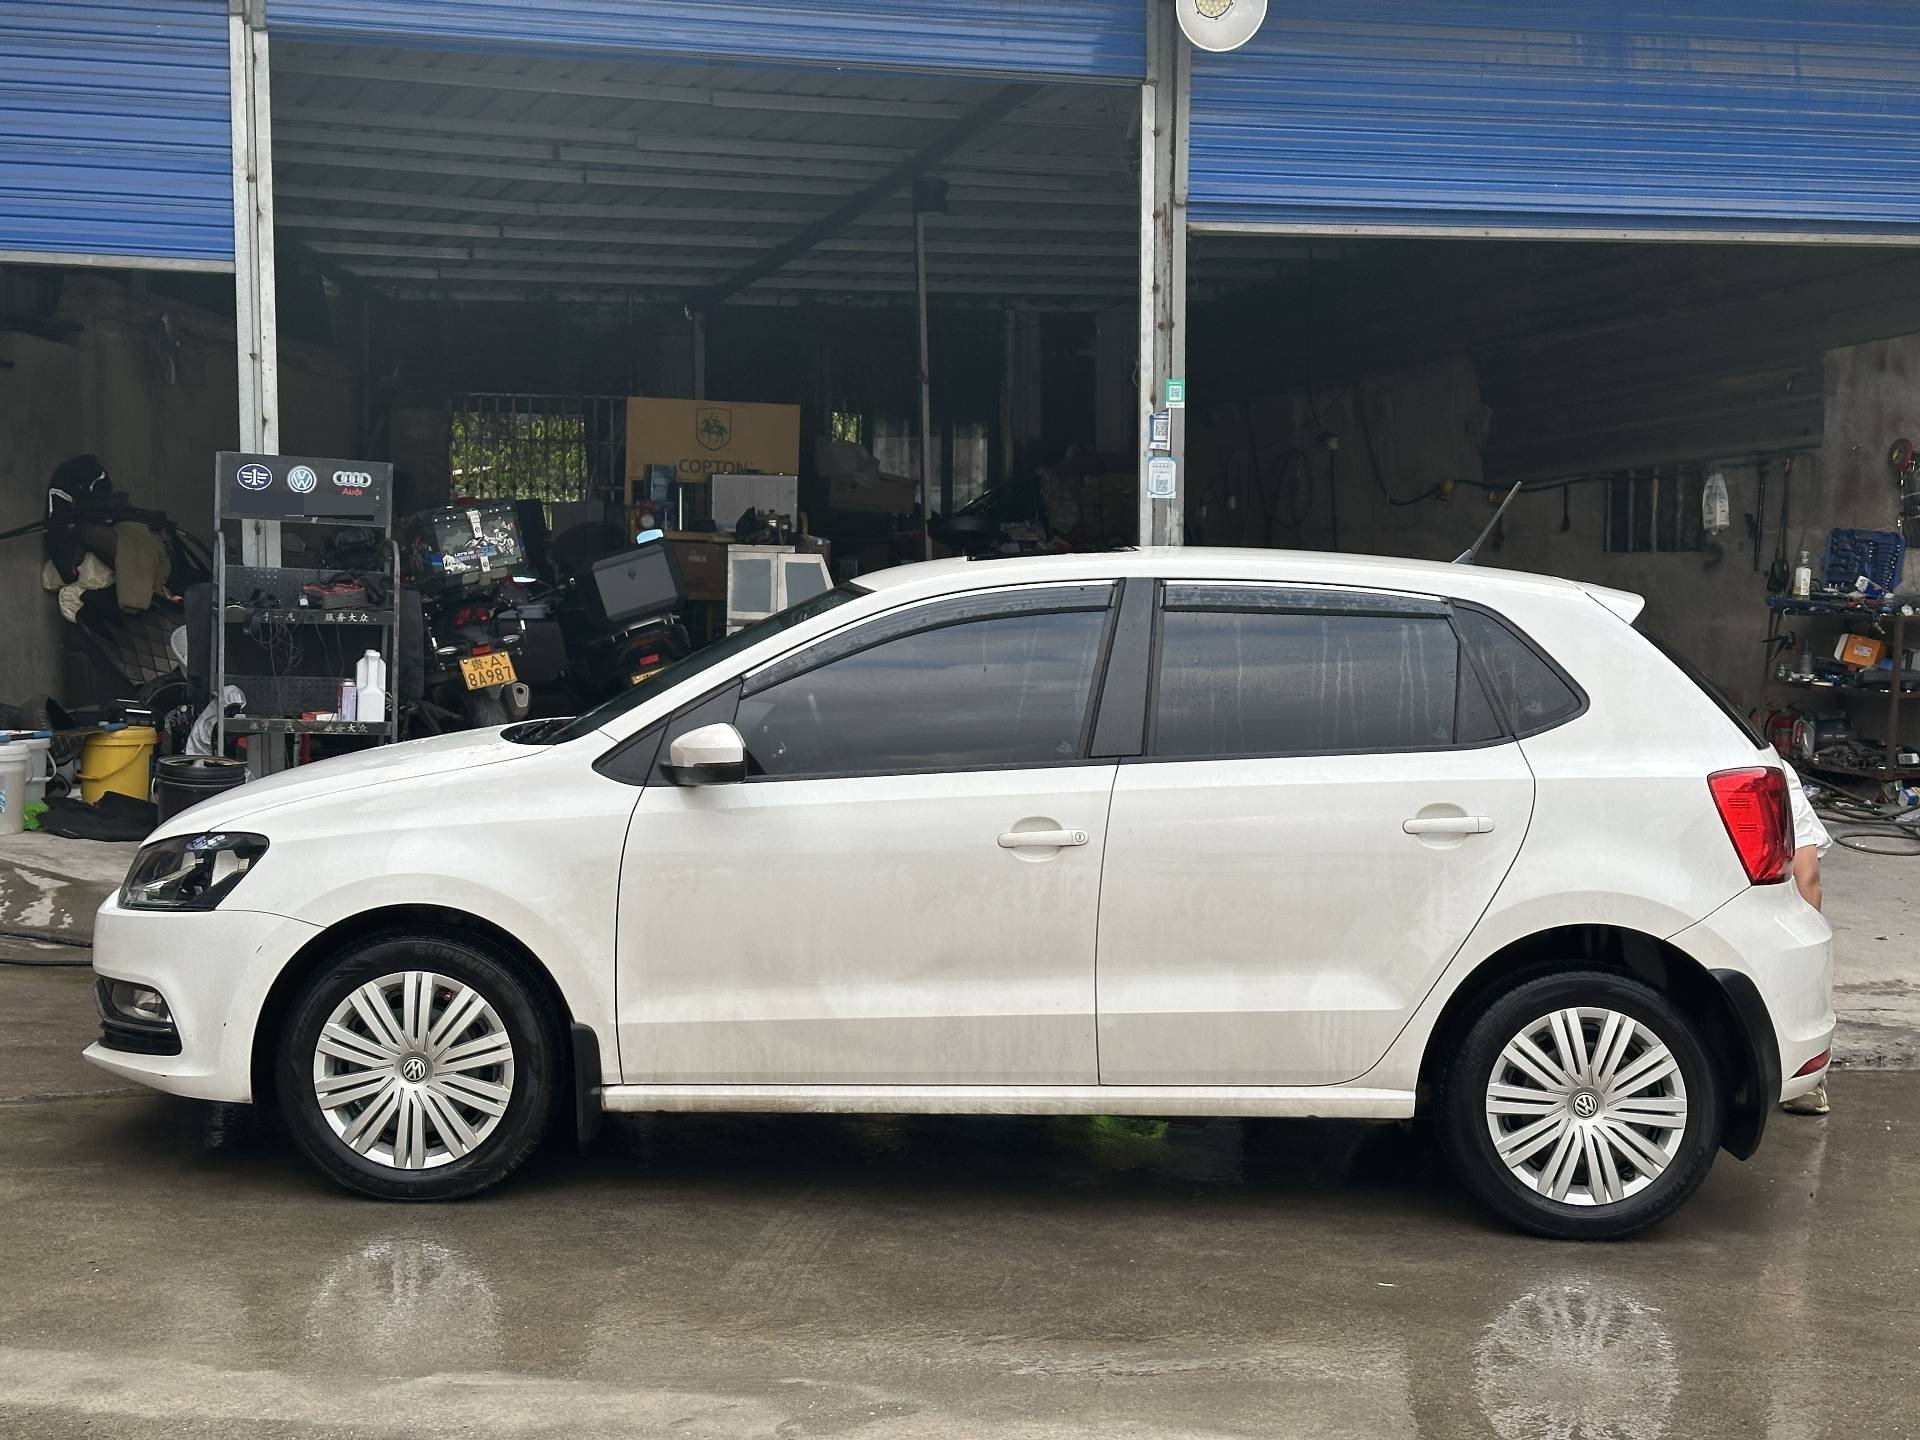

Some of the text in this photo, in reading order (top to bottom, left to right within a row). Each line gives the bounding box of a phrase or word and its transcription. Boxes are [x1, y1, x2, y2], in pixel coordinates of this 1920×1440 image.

[679, 459, 748, 473] COPTON
[342, 488, 363, 496] Audi
[251, 612, 369, 622] 于一汽 服务大众
[468, 666, 512, 687] 8A987
